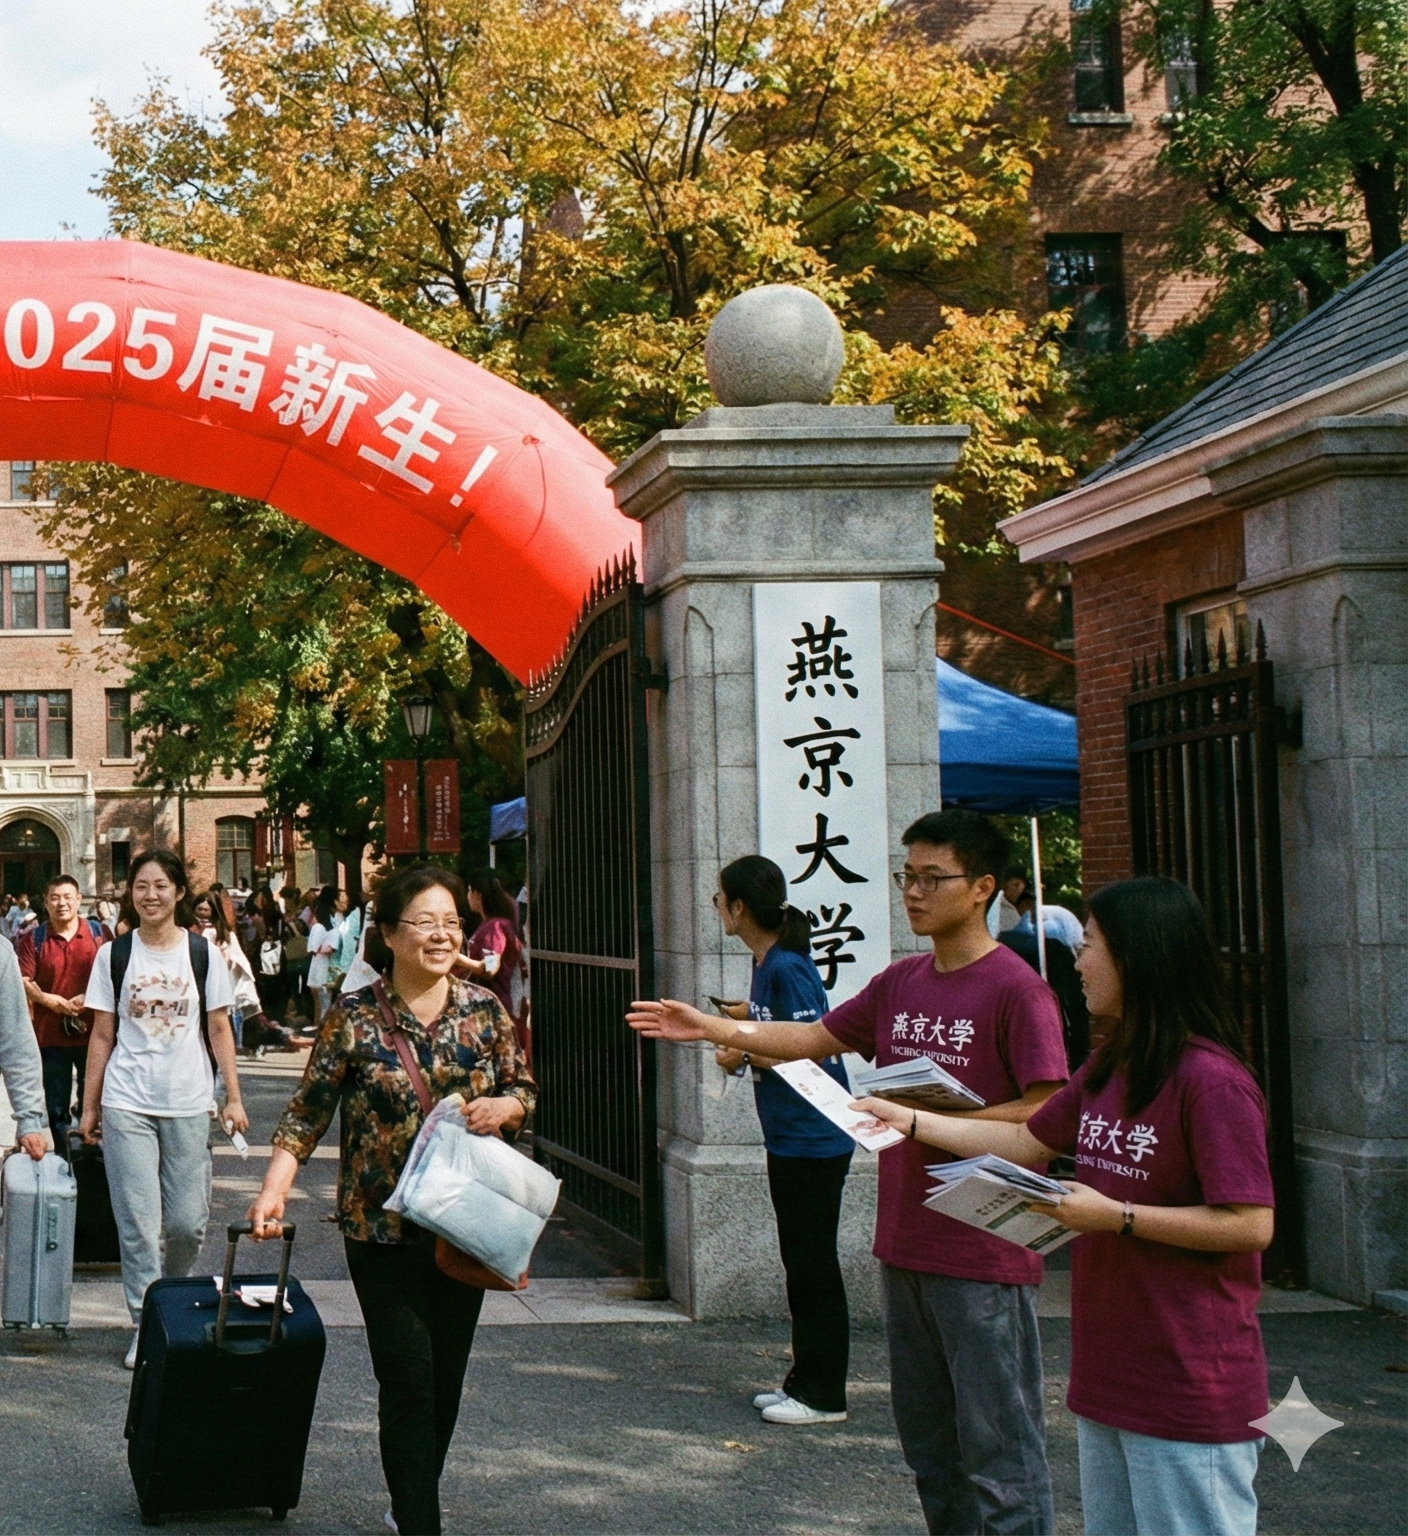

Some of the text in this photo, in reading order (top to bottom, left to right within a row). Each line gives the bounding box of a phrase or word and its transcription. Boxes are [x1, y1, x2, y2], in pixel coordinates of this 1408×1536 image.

[783, 615, 869, 990] 燕京大学
[892, 1011, 975, 1052] 燕京大学
